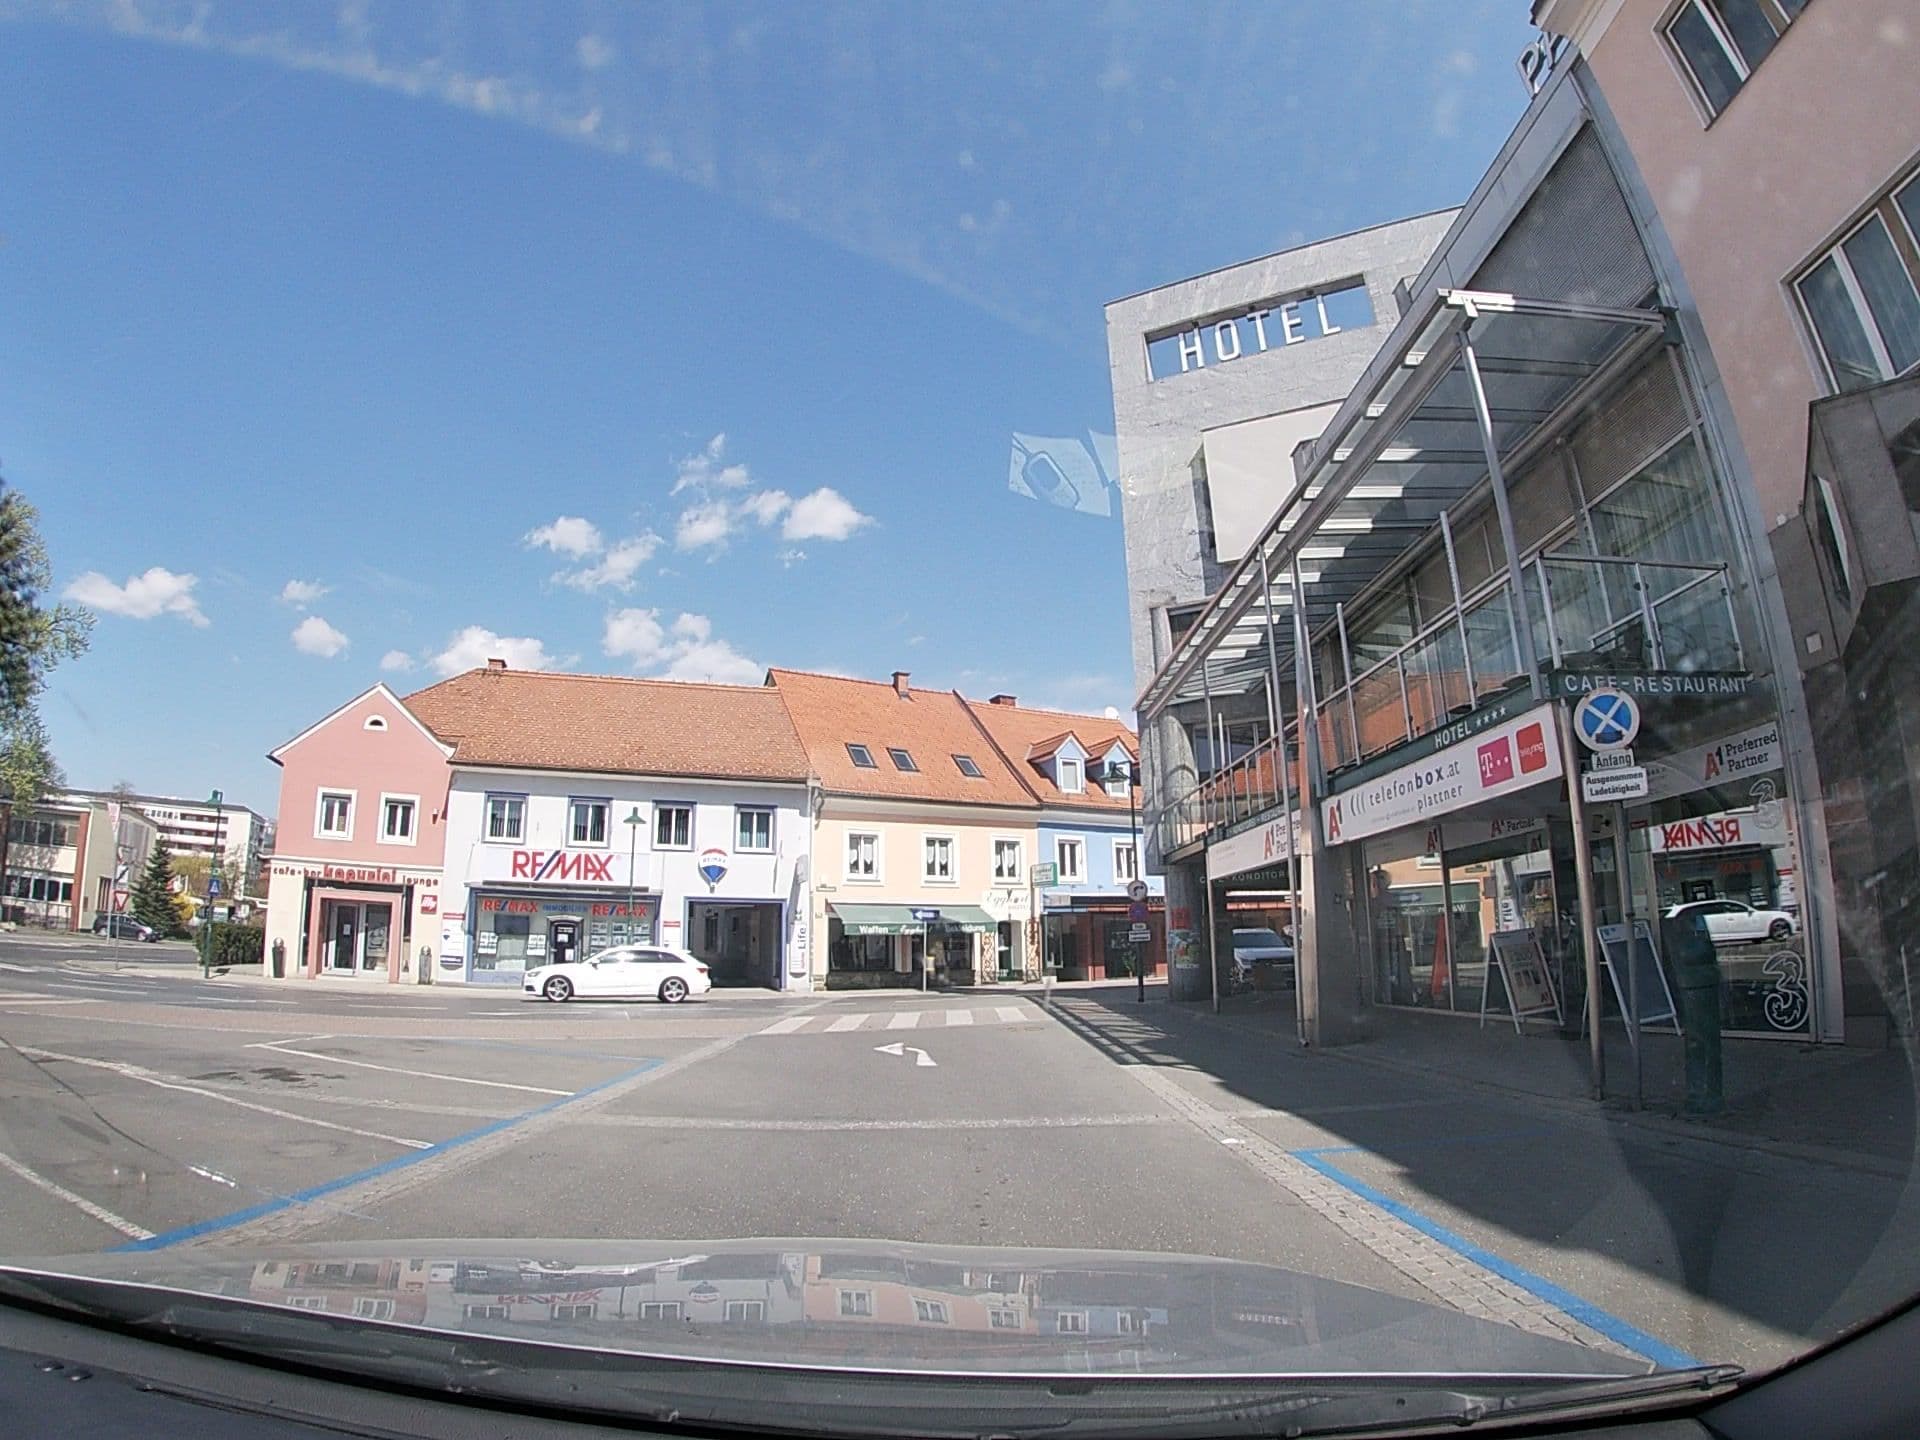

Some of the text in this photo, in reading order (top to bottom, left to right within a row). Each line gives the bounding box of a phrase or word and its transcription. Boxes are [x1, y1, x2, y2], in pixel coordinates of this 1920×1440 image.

[1178, 294, 1342, 373] HOTEL
[1434, 722, 1472, 749] HOTEL
[1725, 731, 1778, 756] Preferred
[1596, 752, 1632, 768] Anfang
[1705, 746, 1724, 781] A1
[1728, 751, 1769, 772] Partner
[1369, 760, 1461, 808] telefonbox.at
[1586, 770, 1643, 785] Ausgenommen
[1589, 783, 1641, 797] Ladetätigkeit
[1417, 785, 1463, 814] plattner
[1328, 799, 1343, 842] A1
[512, 850, 615, 881] RE/MAX
